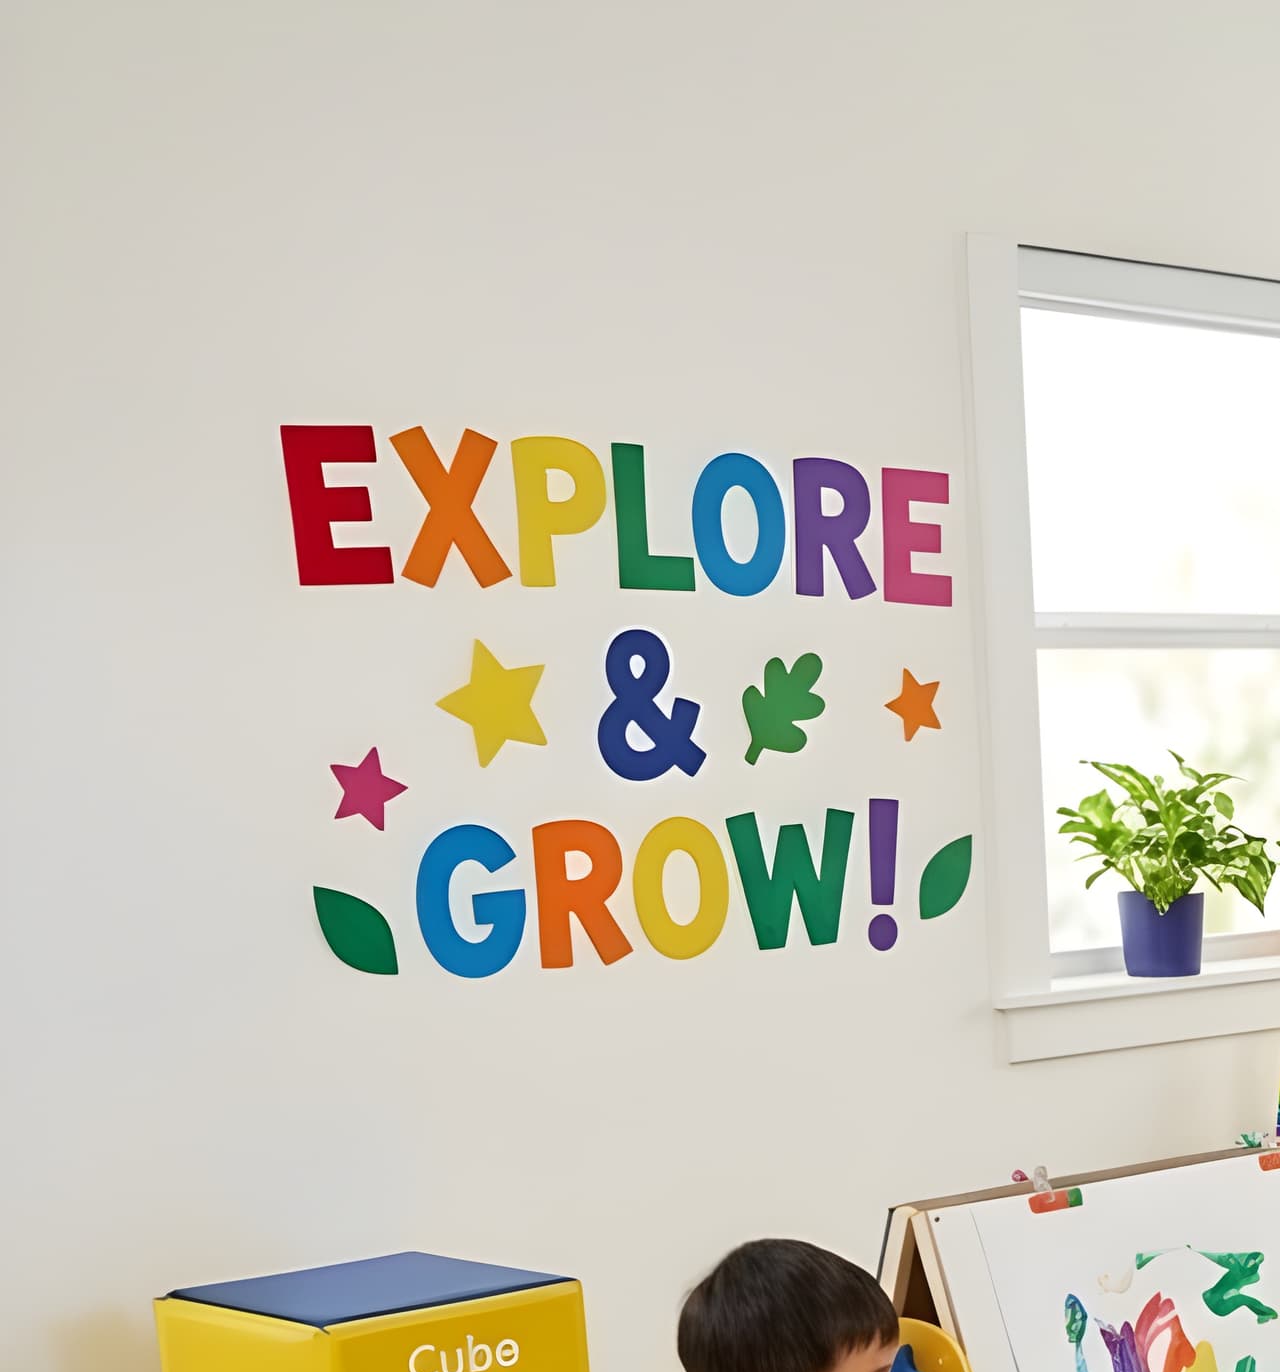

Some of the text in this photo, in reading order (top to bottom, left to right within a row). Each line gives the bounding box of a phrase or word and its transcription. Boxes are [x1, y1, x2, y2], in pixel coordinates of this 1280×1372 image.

[280, 425, 952, 607] EXPLORE
[598, 629, 707, 781] &
[416, 798, 899, 978] GROW!
